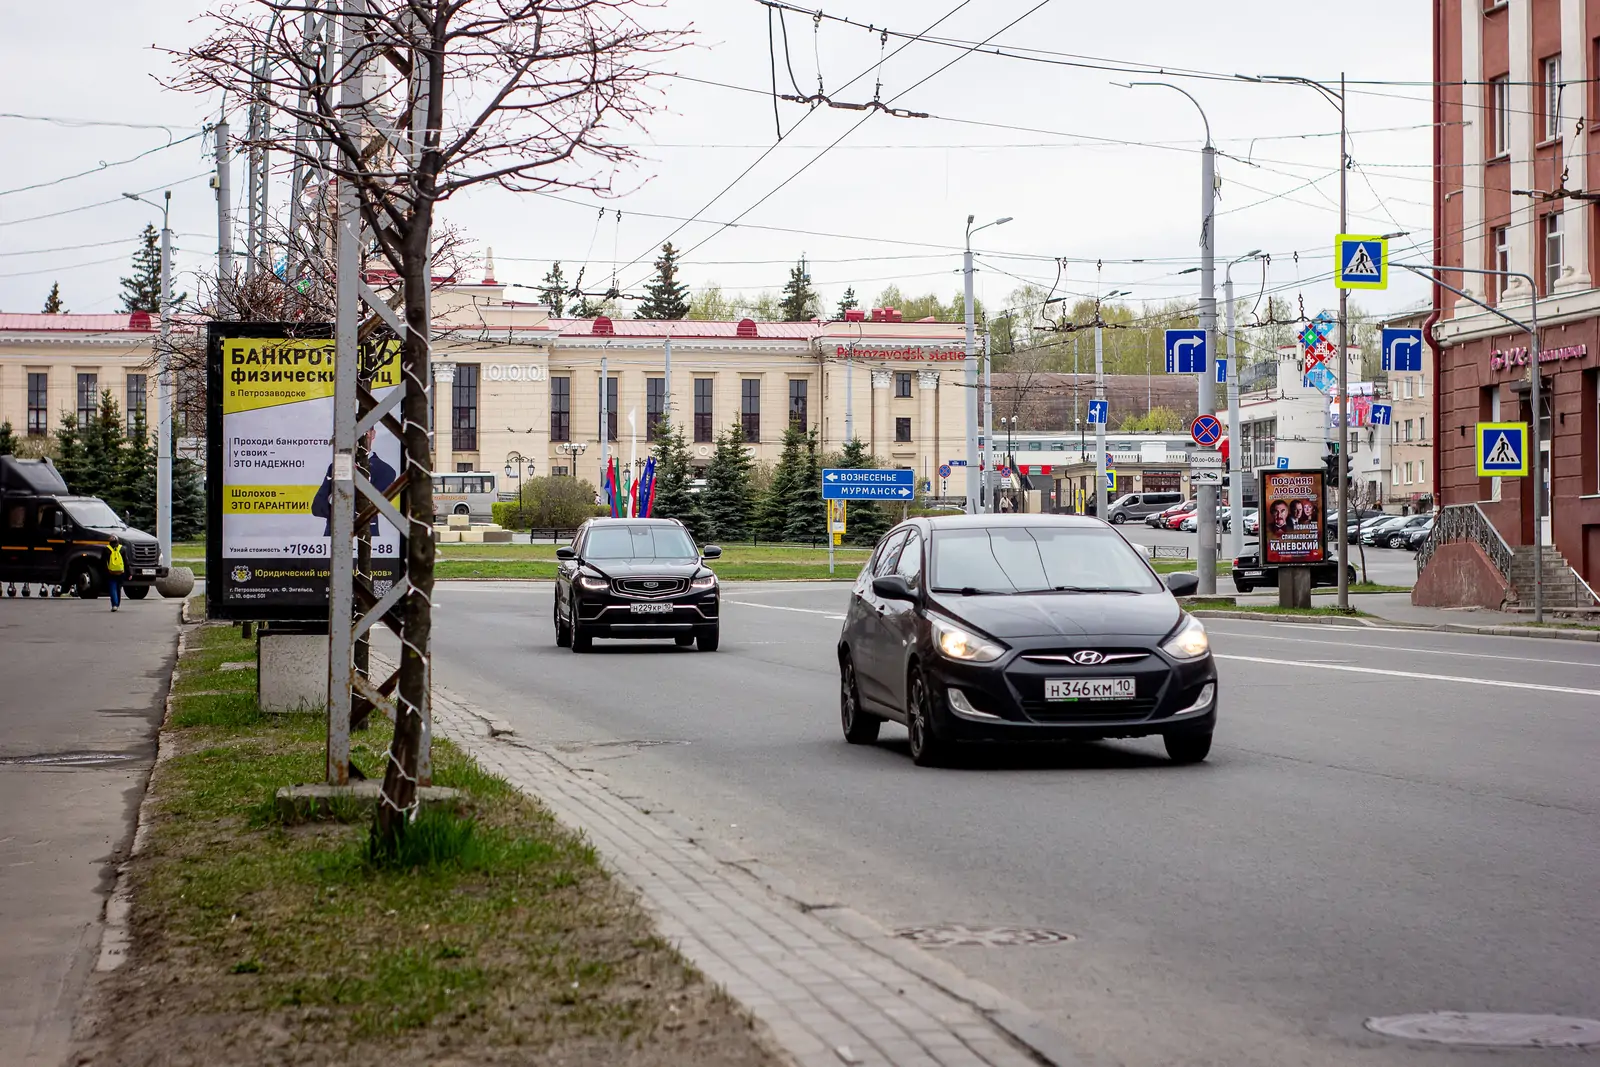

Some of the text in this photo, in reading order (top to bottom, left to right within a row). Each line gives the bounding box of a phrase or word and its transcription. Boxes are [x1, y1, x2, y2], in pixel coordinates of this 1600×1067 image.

[929, 348, 966, 361] statio
[238, 389, 306, 398] Петрозаводске
[233, 437, 330, 446] Проходи банкротств
[233, 460, 305, 468] ЭТО НАДЕЖНО!
[840, 473, 897, 482] ВОЗНЕСЕНЬЕ
[1271, 476, 1314, 486] ПОЗДНЯЯ
[231, 489, 277, 497] Шолохов
[840, 487, 897, 495] МУРМАНСК
[1273, 486, 1312, 495] ЛЮБОВЬ
[231, 501, 309, 510] ЭТО ГАРАНТИИ!
[1270, 539, 1319, 551] КАНЕВСКИЙ
[254, 568, 316, 578] Юридический
[1051, 680, 1131, 697] Н346КМ 10
